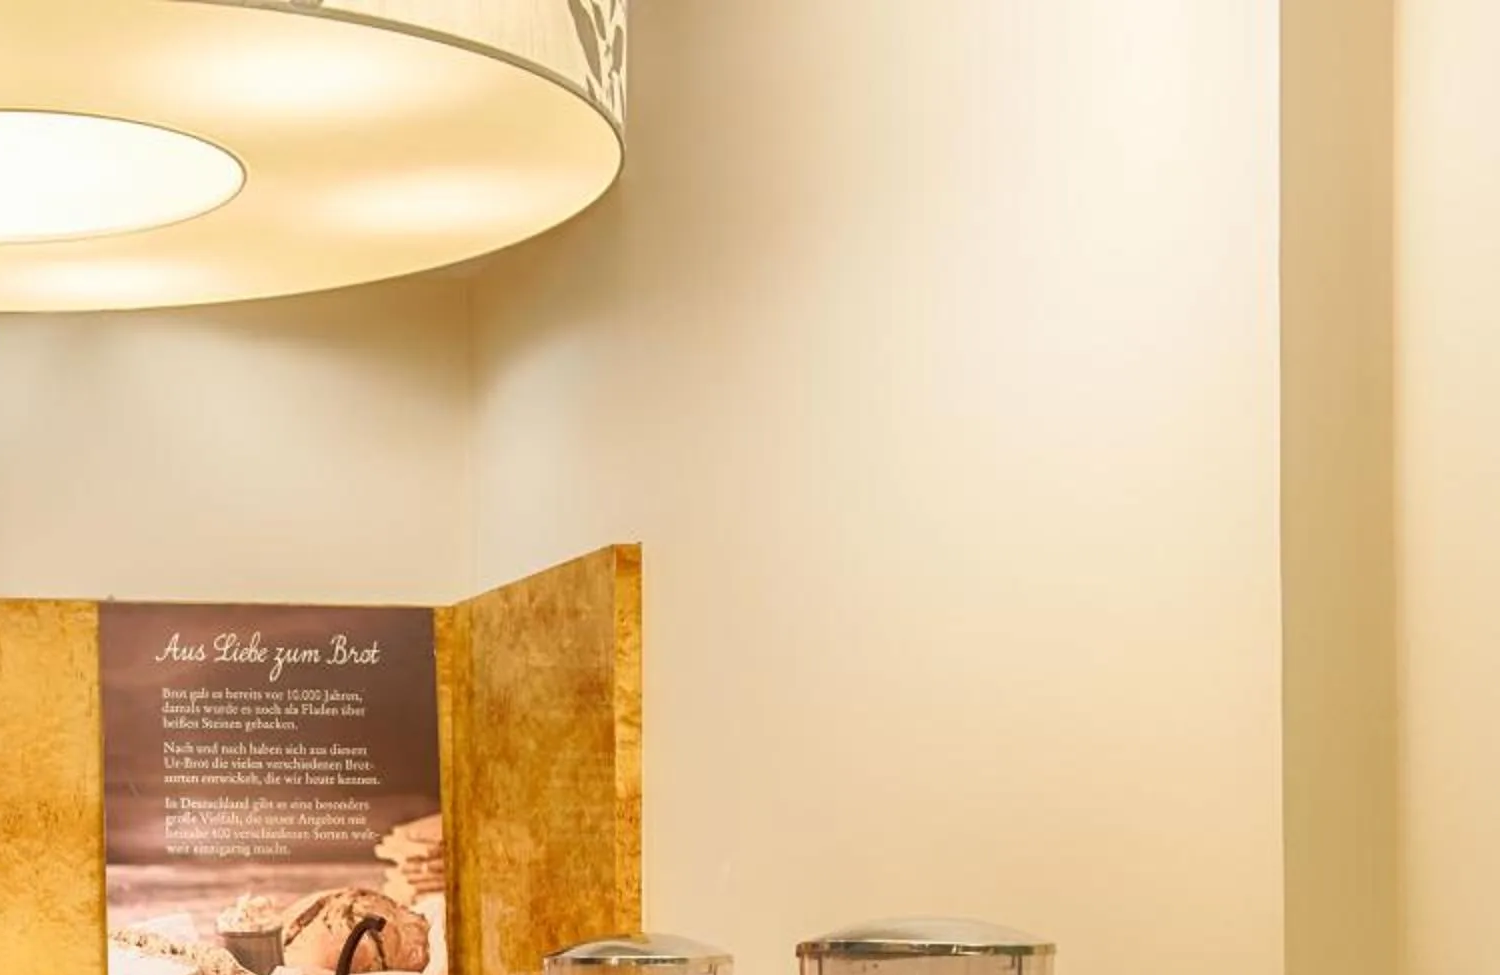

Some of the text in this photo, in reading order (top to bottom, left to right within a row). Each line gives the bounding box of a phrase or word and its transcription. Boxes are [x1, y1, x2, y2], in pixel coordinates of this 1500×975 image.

[156, 631, 380, 682] Aus Liebe zum Brot
